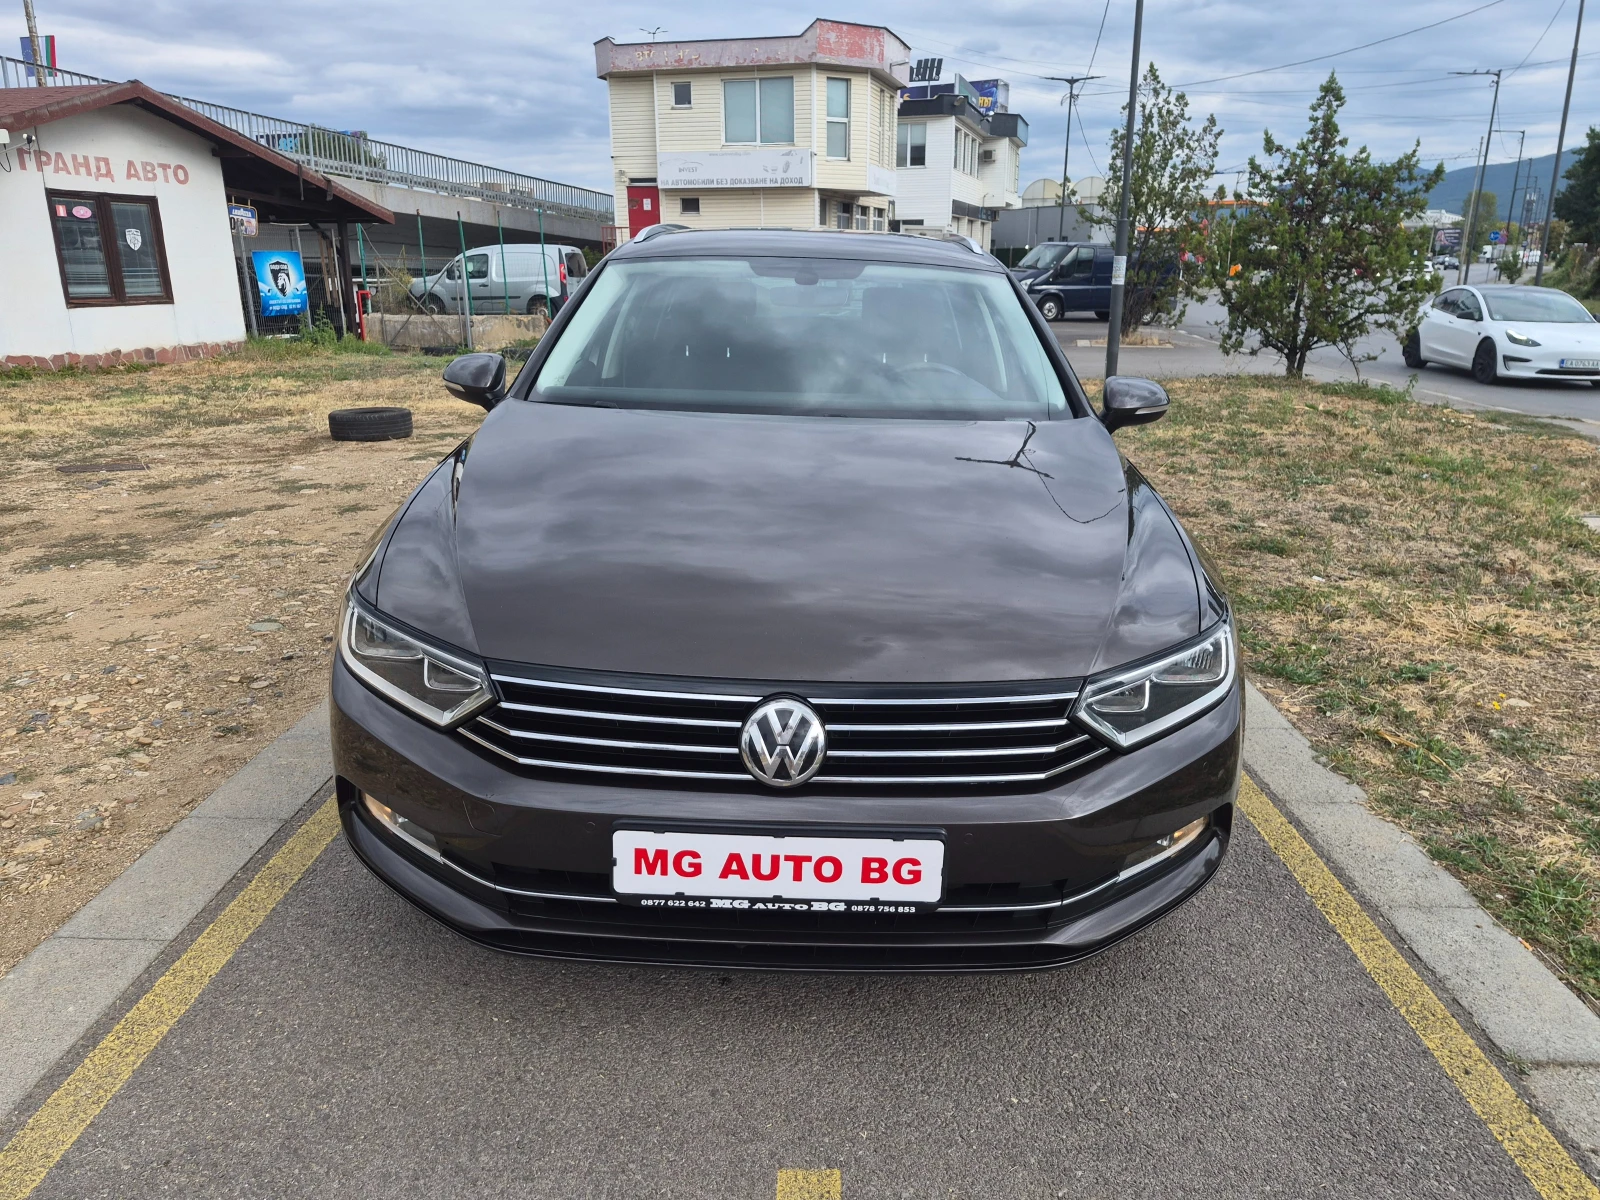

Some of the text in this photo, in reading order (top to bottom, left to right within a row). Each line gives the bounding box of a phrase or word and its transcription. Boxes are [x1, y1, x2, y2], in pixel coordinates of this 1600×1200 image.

[16, 147, 190, 185] ГРАНД АВТО
[671, 178, 715, 186] АВТОМОБИЛИ
[716, 177, 728, 186] БЕЗ
[730, 177, 768, 186] ДОКАЗВАНЕ
[769, 177, 779, 185] НА
[780, 176, 804, 186] ДОХОД
[633, 847, 923, 886] MG AUTO BG
[640, 899, 706, 908] 0877 622 642
[709, 898, 847, 912] MG AUTO BG
[851, 904, 916, 914] 0878 756 853
